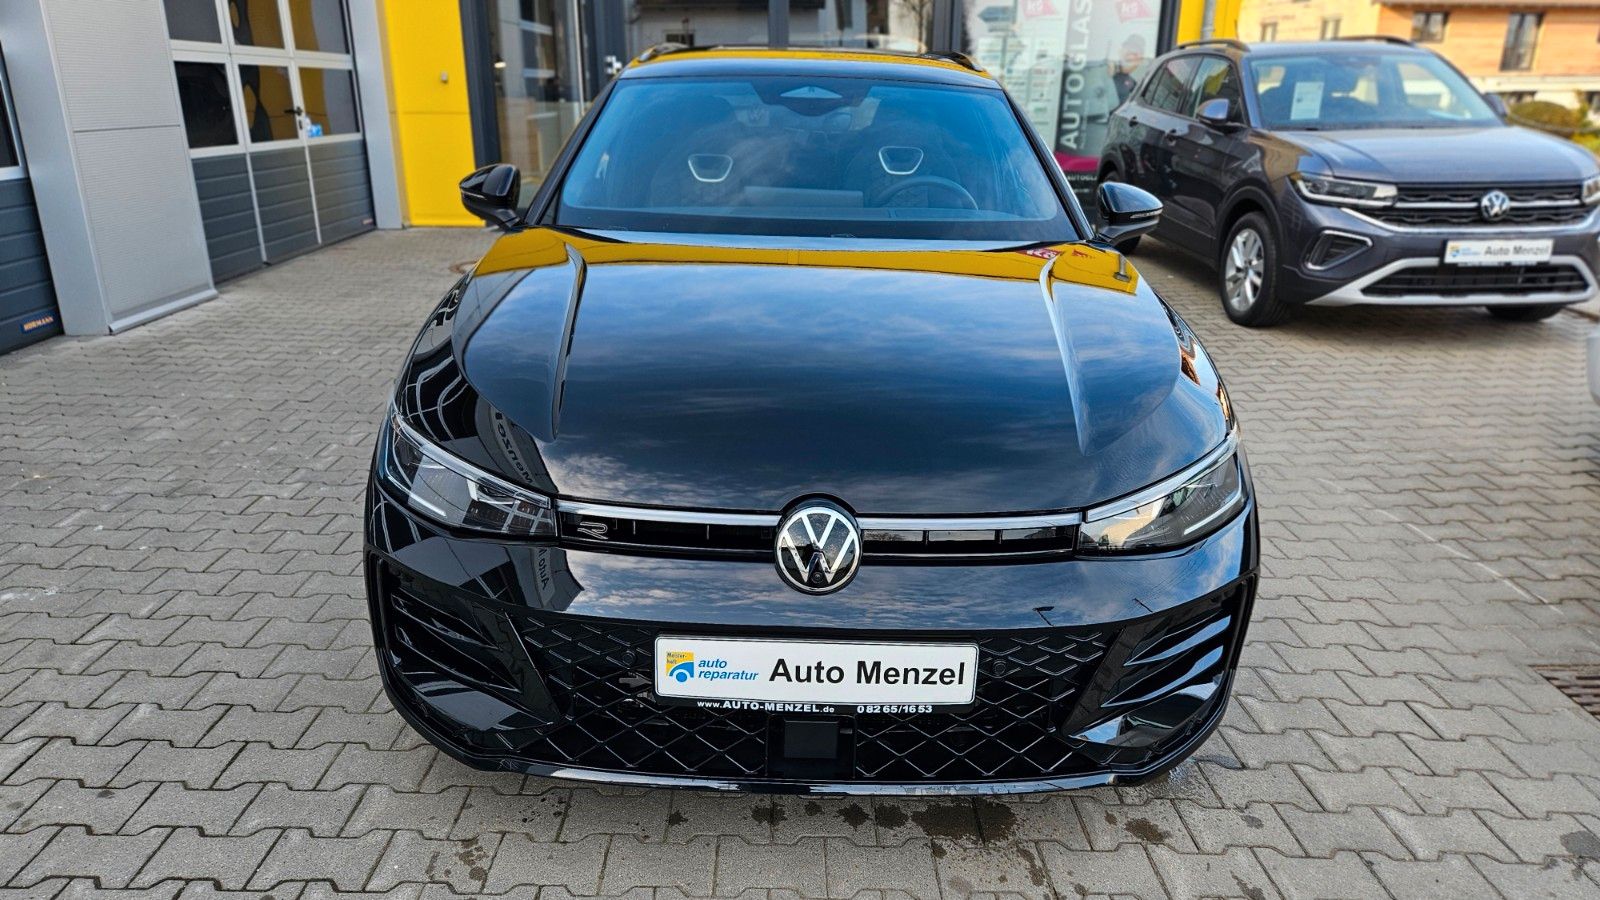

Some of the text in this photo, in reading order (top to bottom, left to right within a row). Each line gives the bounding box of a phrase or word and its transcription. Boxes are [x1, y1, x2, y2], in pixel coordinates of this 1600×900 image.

[1060, 0, 1093, 149] AUTOGLAS
[1485, 246, 1510, 256] Auto
[1513, 244, 1549, 256] Menzel
[698, 658, 728, 669] auto
[698, 670, 759, 682] reparatur
[769, 658, 965, 685] Auto Menzel
[696, 700, 835, 713] www.AUTO-MENZEL.de
